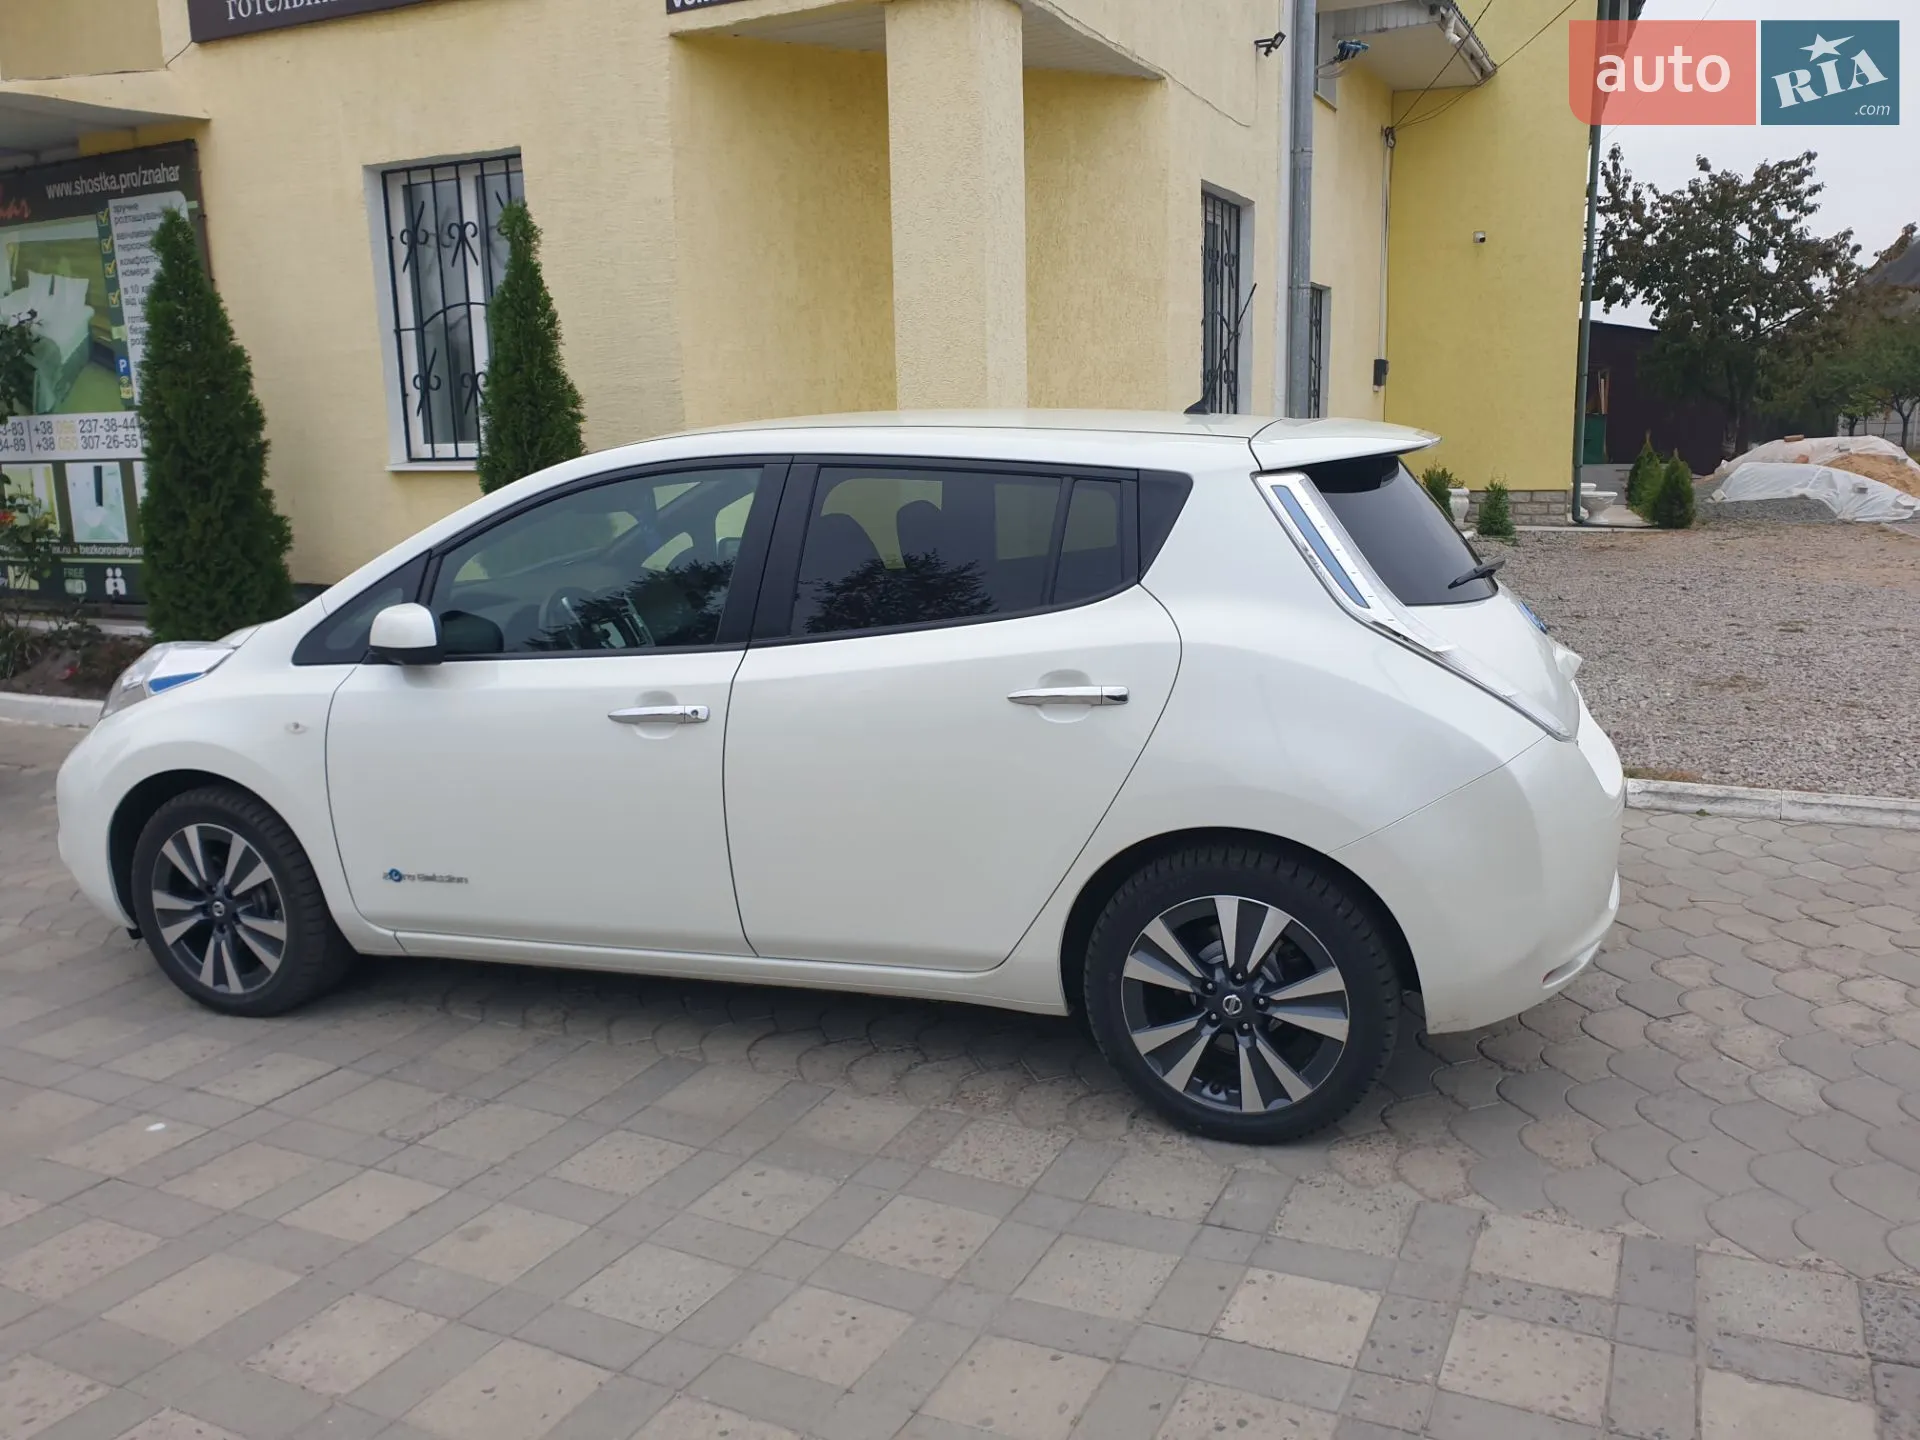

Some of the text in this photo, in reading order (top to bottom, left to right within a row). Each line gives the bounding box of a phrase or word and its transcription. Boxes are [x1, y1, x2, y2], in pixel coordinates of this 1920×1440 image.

[46, 161, 180, 199] www.shostka.pro/znahar
[33, 420, 53, 435] +38
[79, 417, 137, 433] 237-38-44
[36, 436, 55, 451] +38
[81, 434, 138, 449] 307-26-55
[64, 567, 84, 577] FREE
